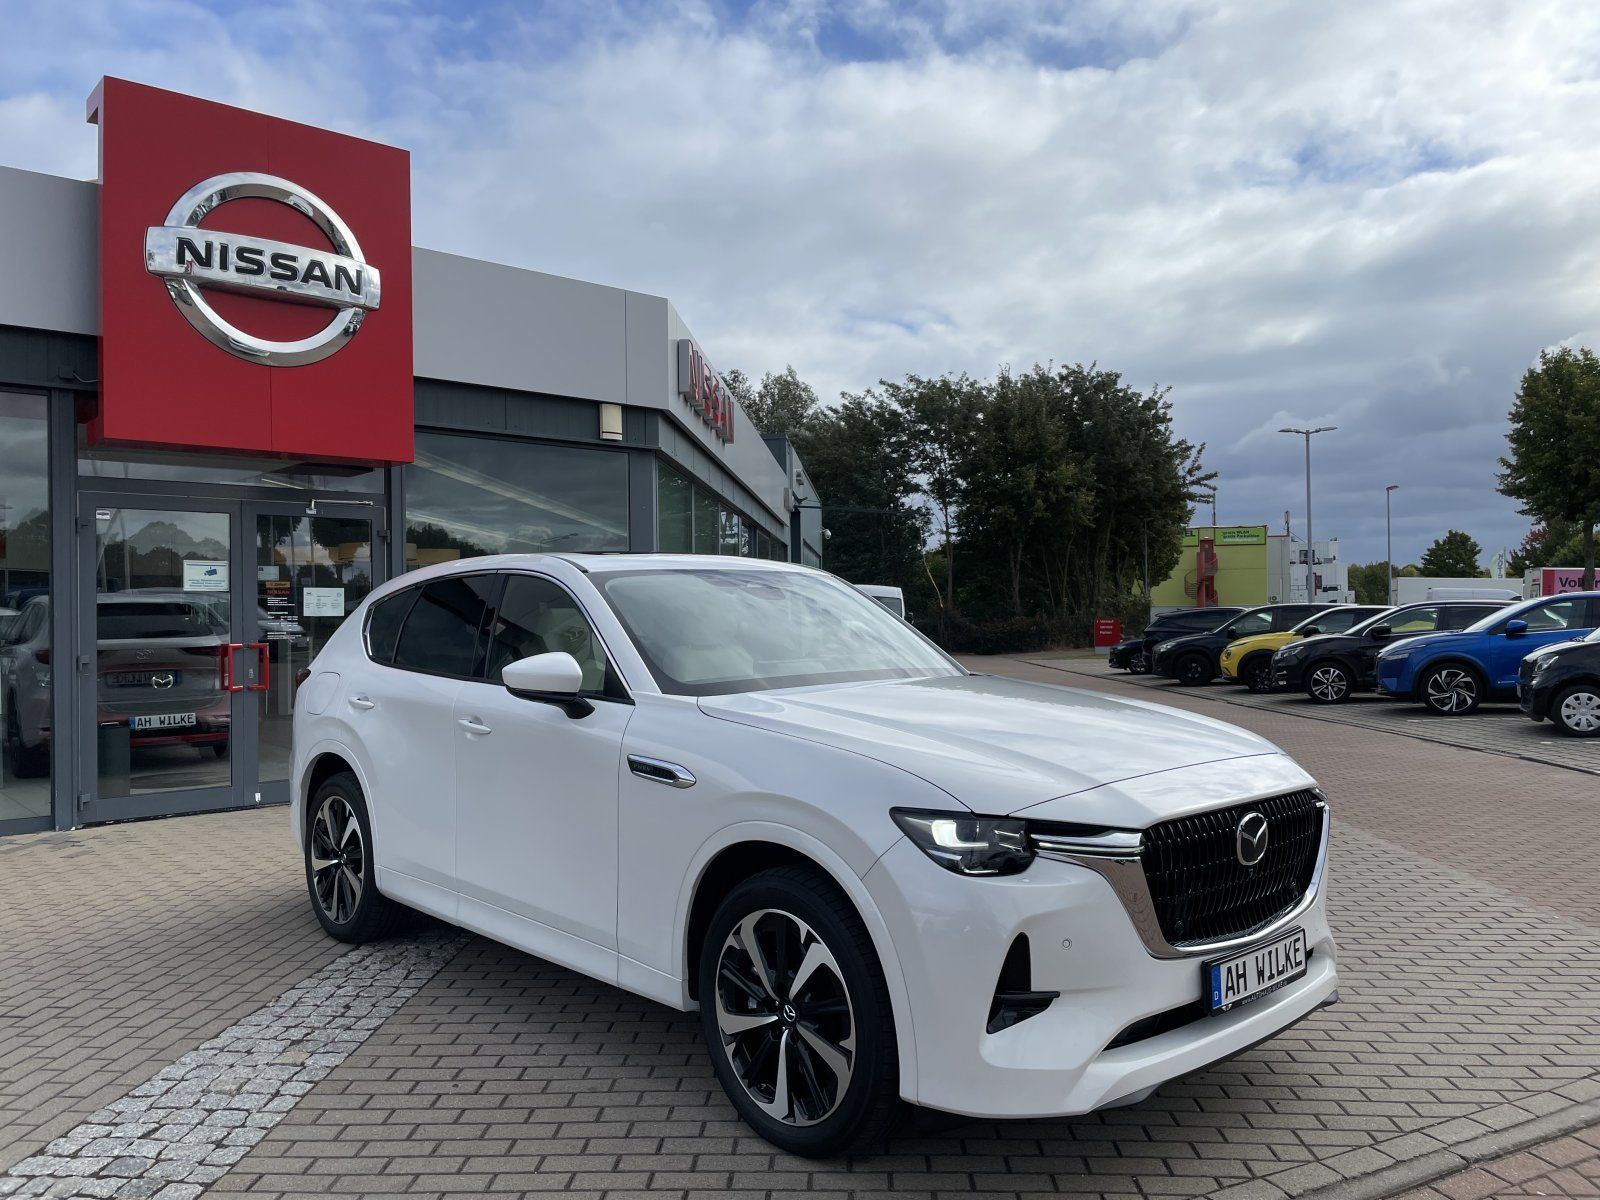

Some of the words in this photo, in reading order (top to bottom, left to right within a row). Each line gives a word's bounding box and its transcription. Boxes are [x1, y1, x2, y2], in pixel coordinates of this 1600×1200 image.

[176, 237, 363, 297] NISSAN
[136, 717, 152, 728] AH
[158, 714, 195, 726] WILKE
[1225, 960, 1248, 999] AH
[1255, 936, 1303, 986] WILKE
